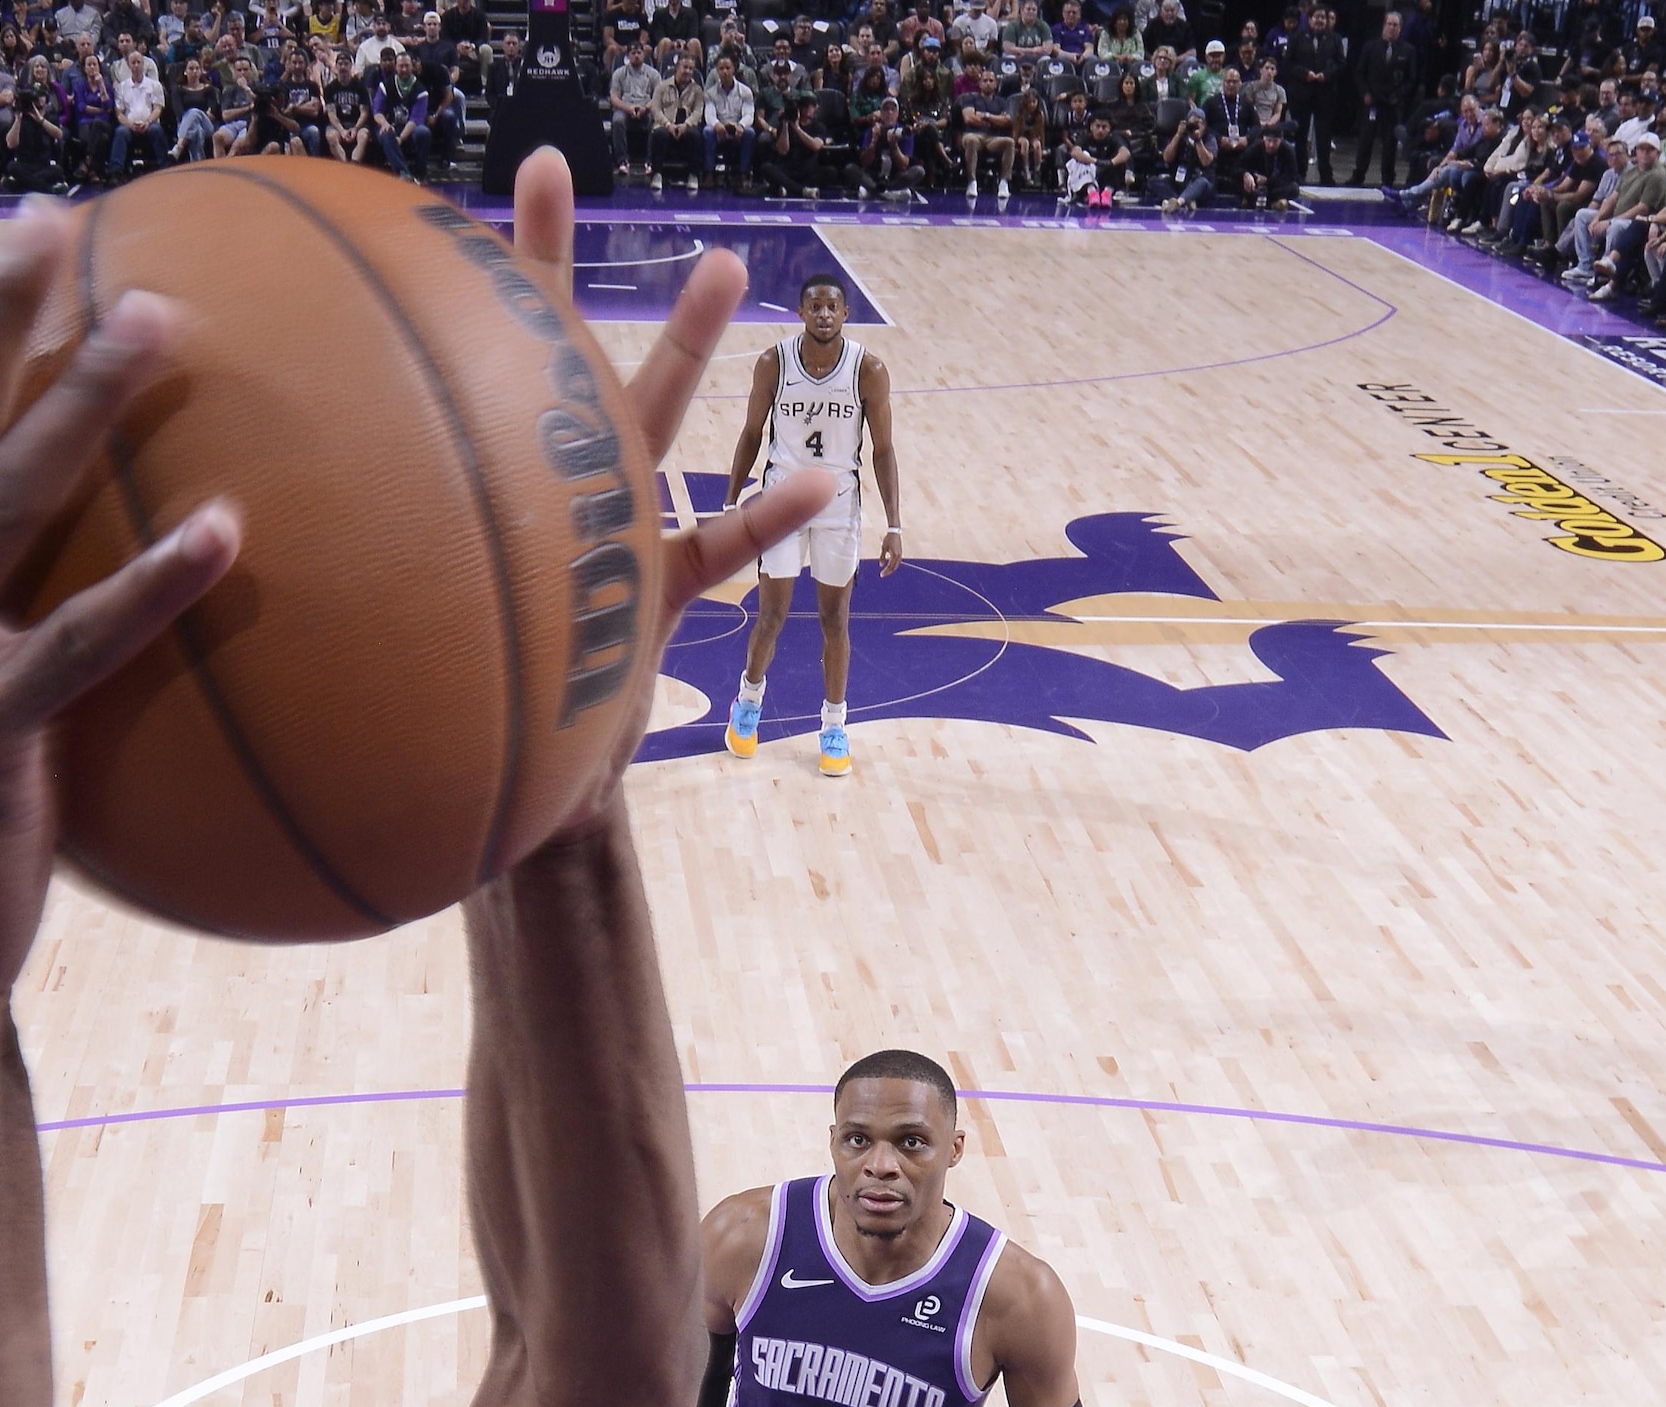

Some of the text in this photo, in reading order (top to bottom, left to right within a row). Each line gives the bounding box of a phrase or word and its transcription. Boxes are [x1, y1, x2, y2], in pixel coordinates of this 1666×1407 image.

[526, 67, 570, 76] REDHAWK
[779, 401, 855, 425] SPURS
[1356, 383, 1510, 451] CENTER
[805, 431, 823, 457] 4
